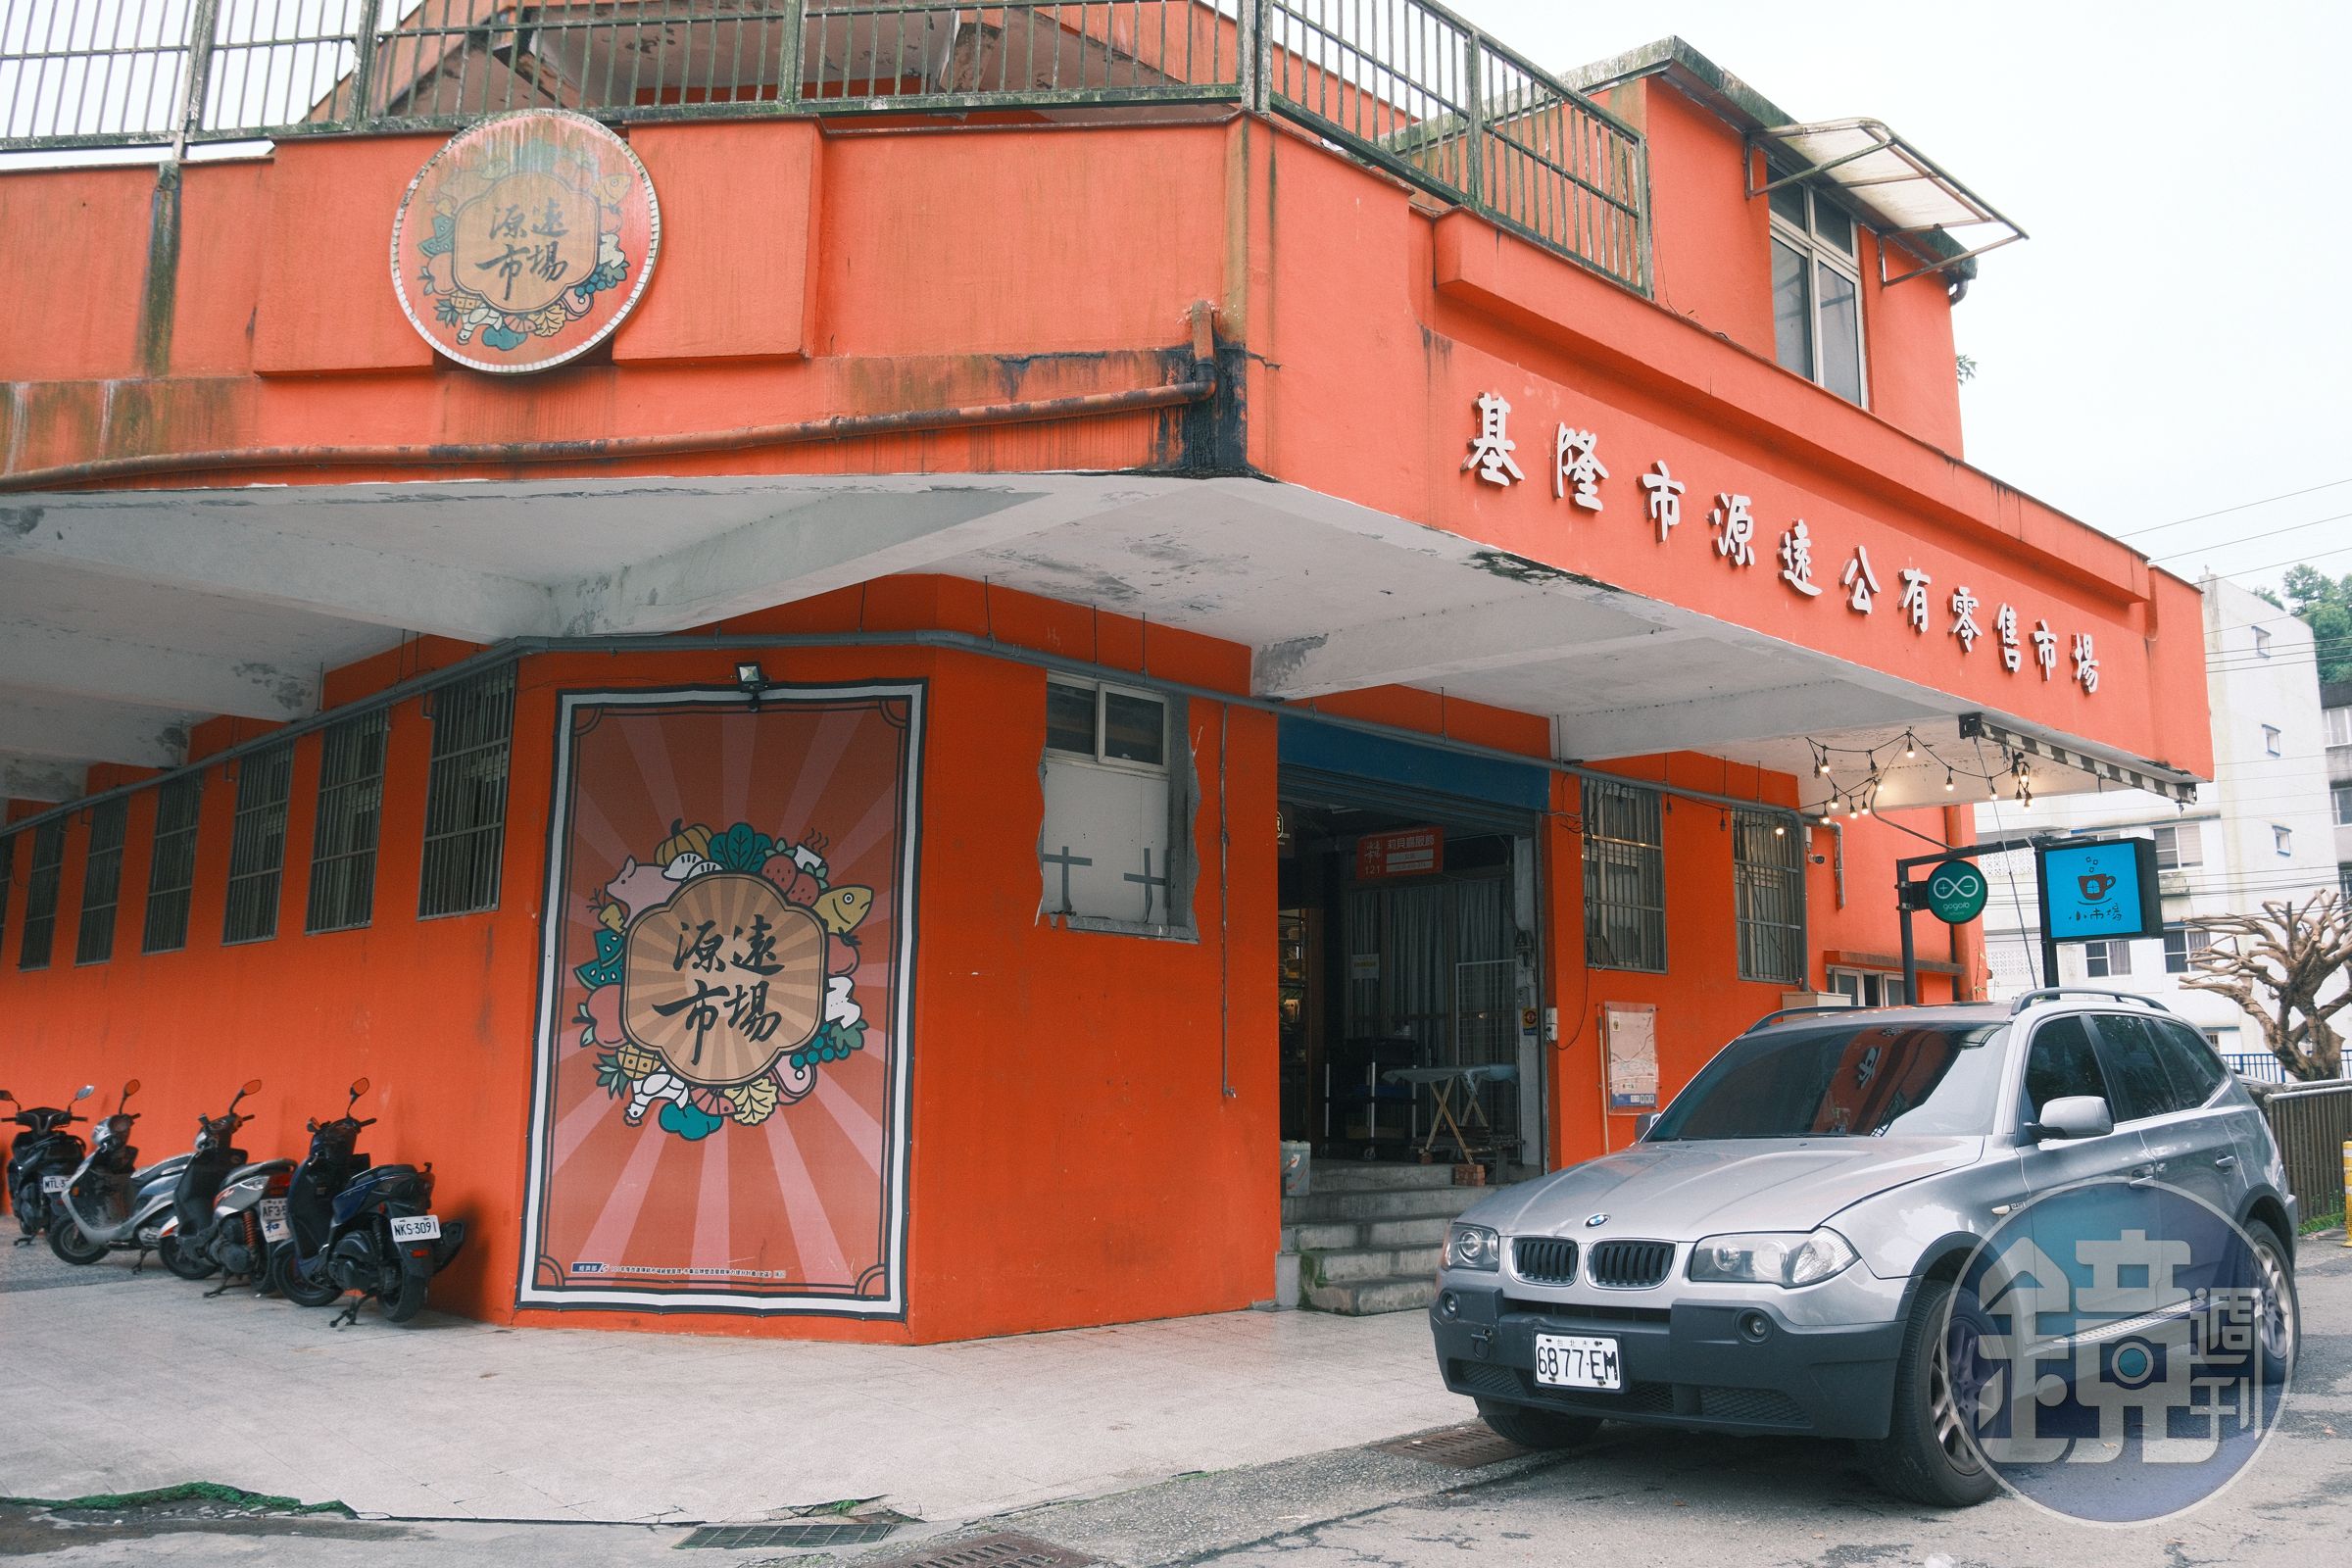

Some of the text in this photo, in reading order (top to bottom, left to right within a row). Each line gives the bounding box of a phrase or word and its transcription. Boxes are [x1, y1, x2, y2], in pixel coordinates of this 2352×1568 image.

[489, 198, 569, 239] 源遠
[475, 241, 568, 301] 市場
[1465, 393, 2100, 695] 基隆市源遠公有零售市場
[2069, 903, 2122, 921] 小市場
[673, 914, 785, 975] 源遠
[652, 979, 782, 1065] 市場
[394, 1221, 437, 1236] NKS-3091
